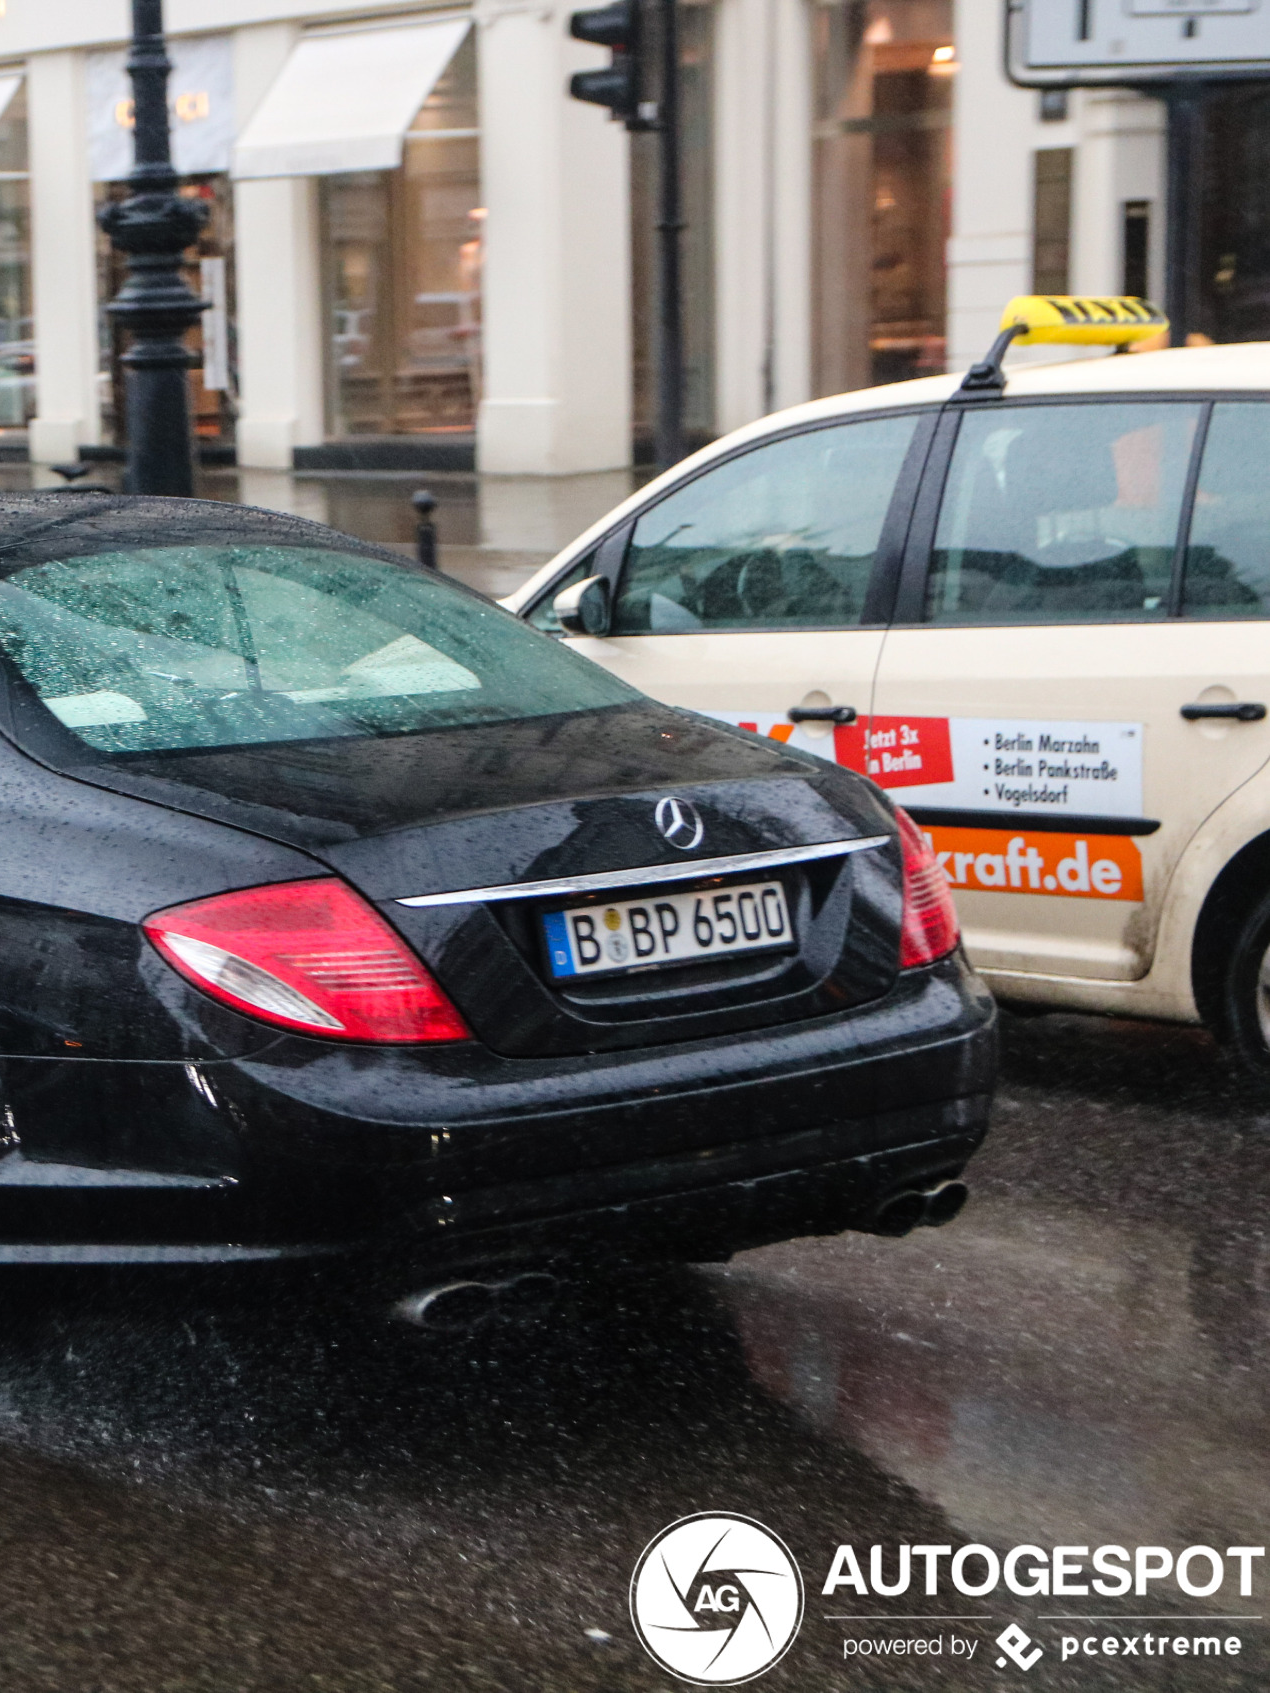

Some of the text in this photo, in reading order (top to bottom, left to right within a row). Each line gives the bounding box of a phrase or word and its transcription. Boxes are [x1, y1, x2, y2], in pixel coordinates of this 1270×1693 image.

[115, 91, 209, 129] GCI
[863, 725, 919, 750] Jetzt 3x
[995, 733, 1100, 753] Berlin Marzahn
[882, 748, 922, 773] Berlin
[995, 758, 1117, 780] Berlin Pankstraße
[995, 783, 1069, 806] Vogelsdorf
[573, 887, 785, 967] B BP 6500
